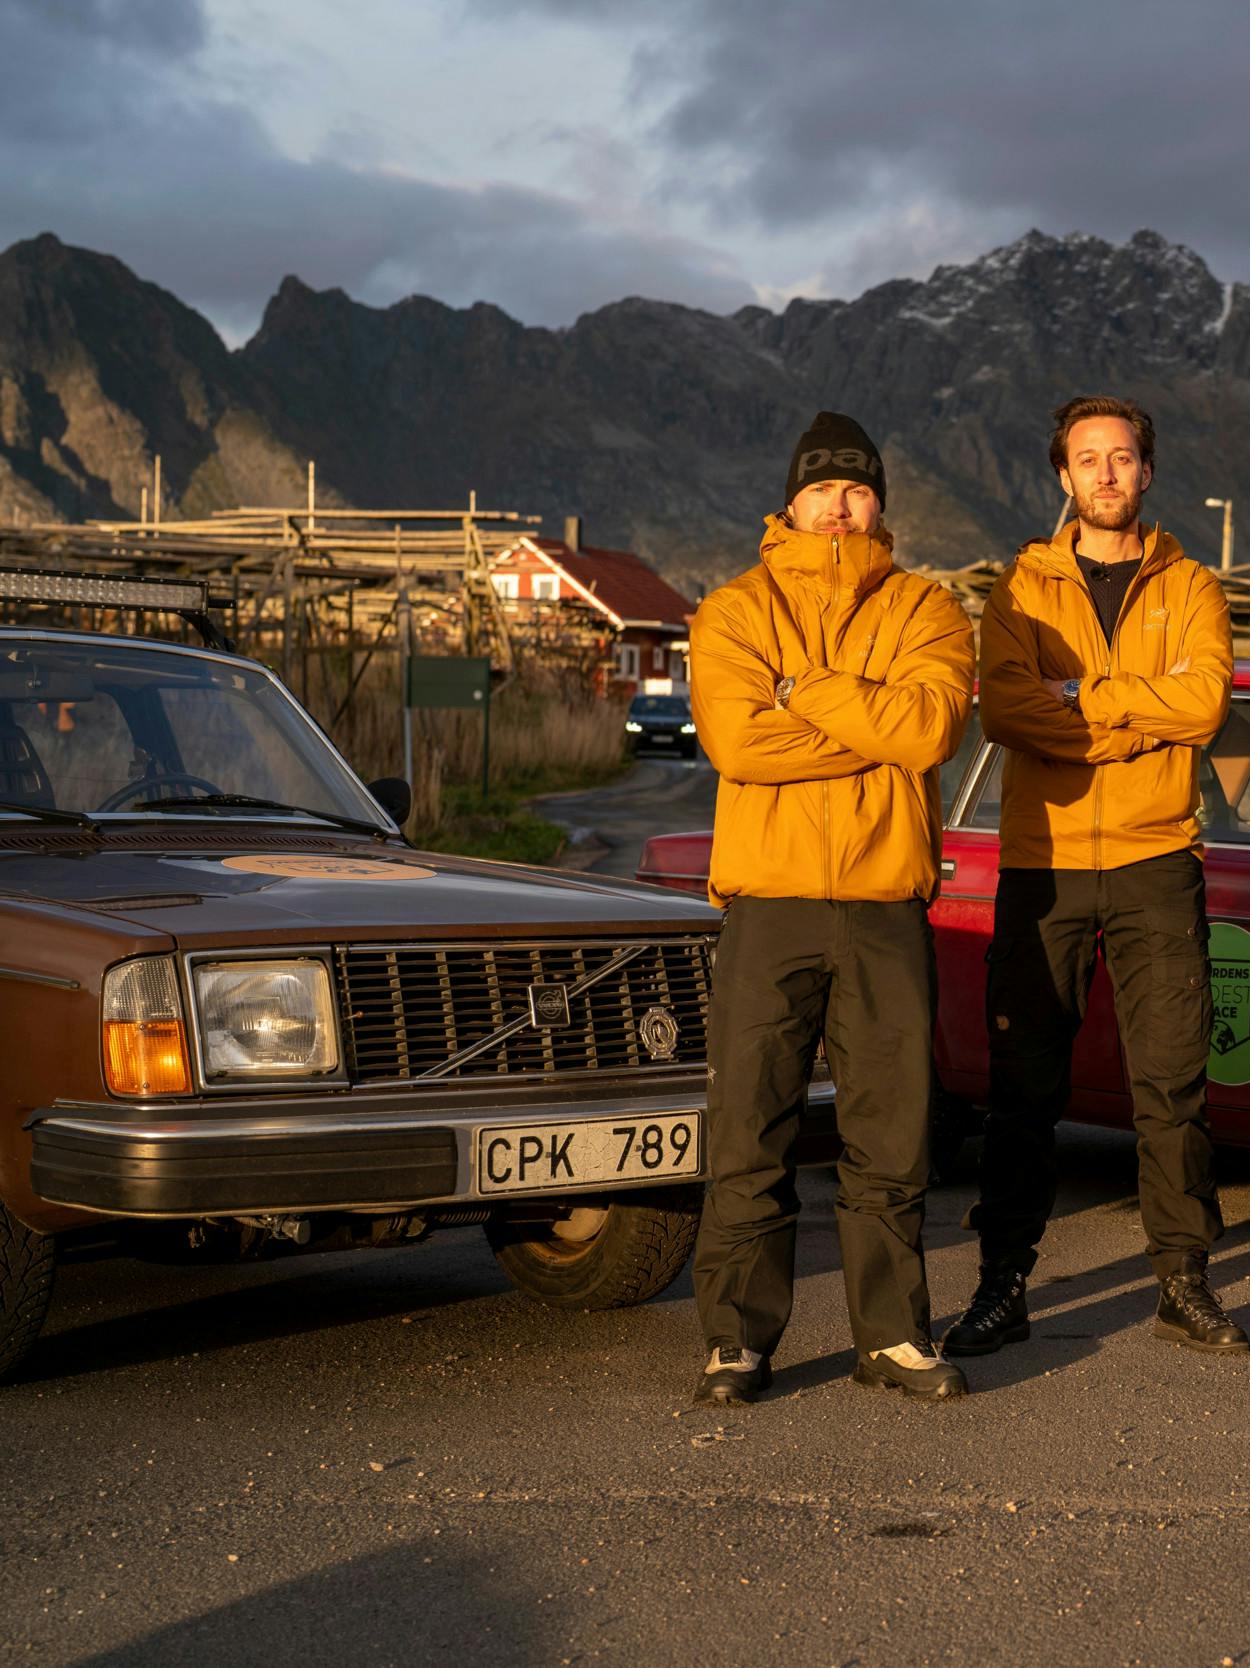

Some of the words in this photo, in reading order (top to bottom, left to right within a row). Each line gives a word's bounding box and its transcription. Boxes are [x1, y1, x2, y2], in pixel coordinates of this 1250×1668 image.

[1210, 968, 1250, 979] RDENS
[1213, 1006, 1238, 1018] ACE
[487, 1132, 576, 1184] CPK
[612, 1122, 692, 1173] 789
